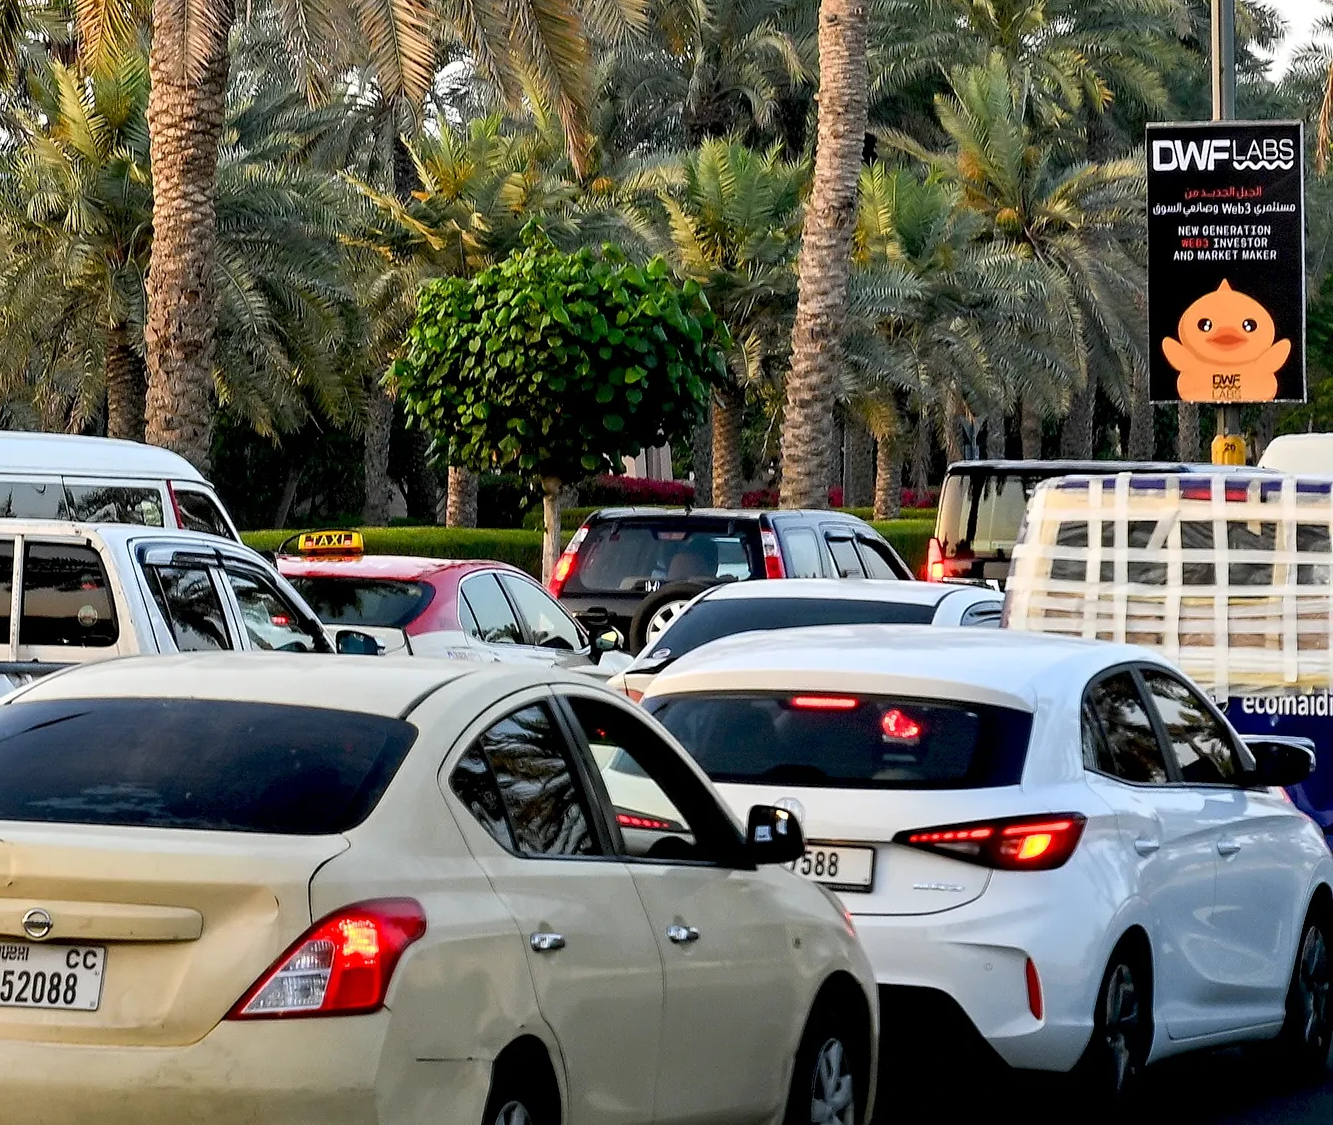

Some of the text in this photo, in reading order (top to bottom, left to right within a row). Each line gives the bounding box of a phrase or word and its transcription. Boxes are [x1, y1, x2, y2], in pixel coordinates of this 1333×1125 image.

[1151, 138, 1295, 171] DWF LABS
[1221, 202, 1252, 215] Web3
[1178, 225, 1200, 237] NEW
[1213, 237, 1268, 249] INVESTOR
[1173, 249, 1277, 261] AND MARKET MAKER
[1212, 373, 1241, 386] DWF
[311, 533, 345, 547] TAXI
[64, 948, 99, 970] CC
[0, 969, 78, 1005] 52088
